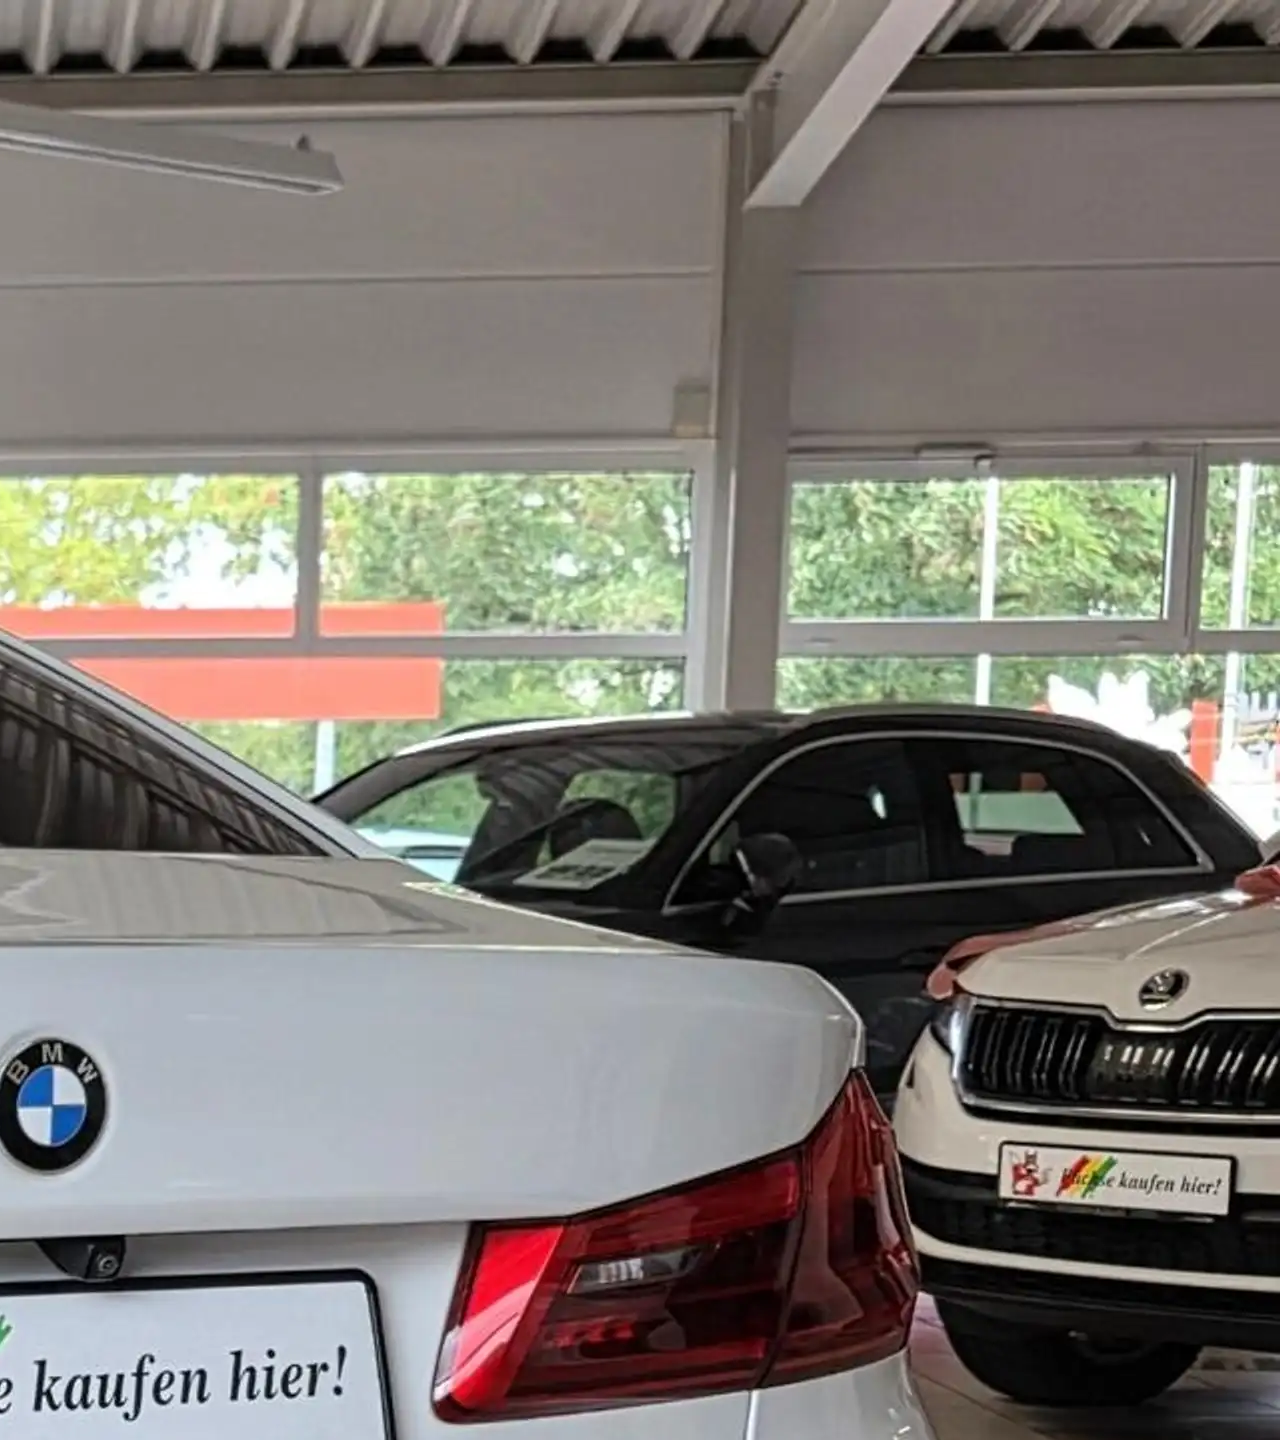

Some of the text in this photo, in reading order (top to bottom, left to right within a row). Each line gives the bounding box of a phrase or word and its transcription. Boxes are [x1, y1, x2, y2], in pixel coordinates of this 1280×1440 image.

[6, 1042, 98, 1085] BMW
[1119, 1171, 1175, 1195] kaufen
[1180, 1175, 1222, 1196] hier!
[33, 1354, 211, 1422] kaufen
[229, 1345, 348, 1401] hier!
